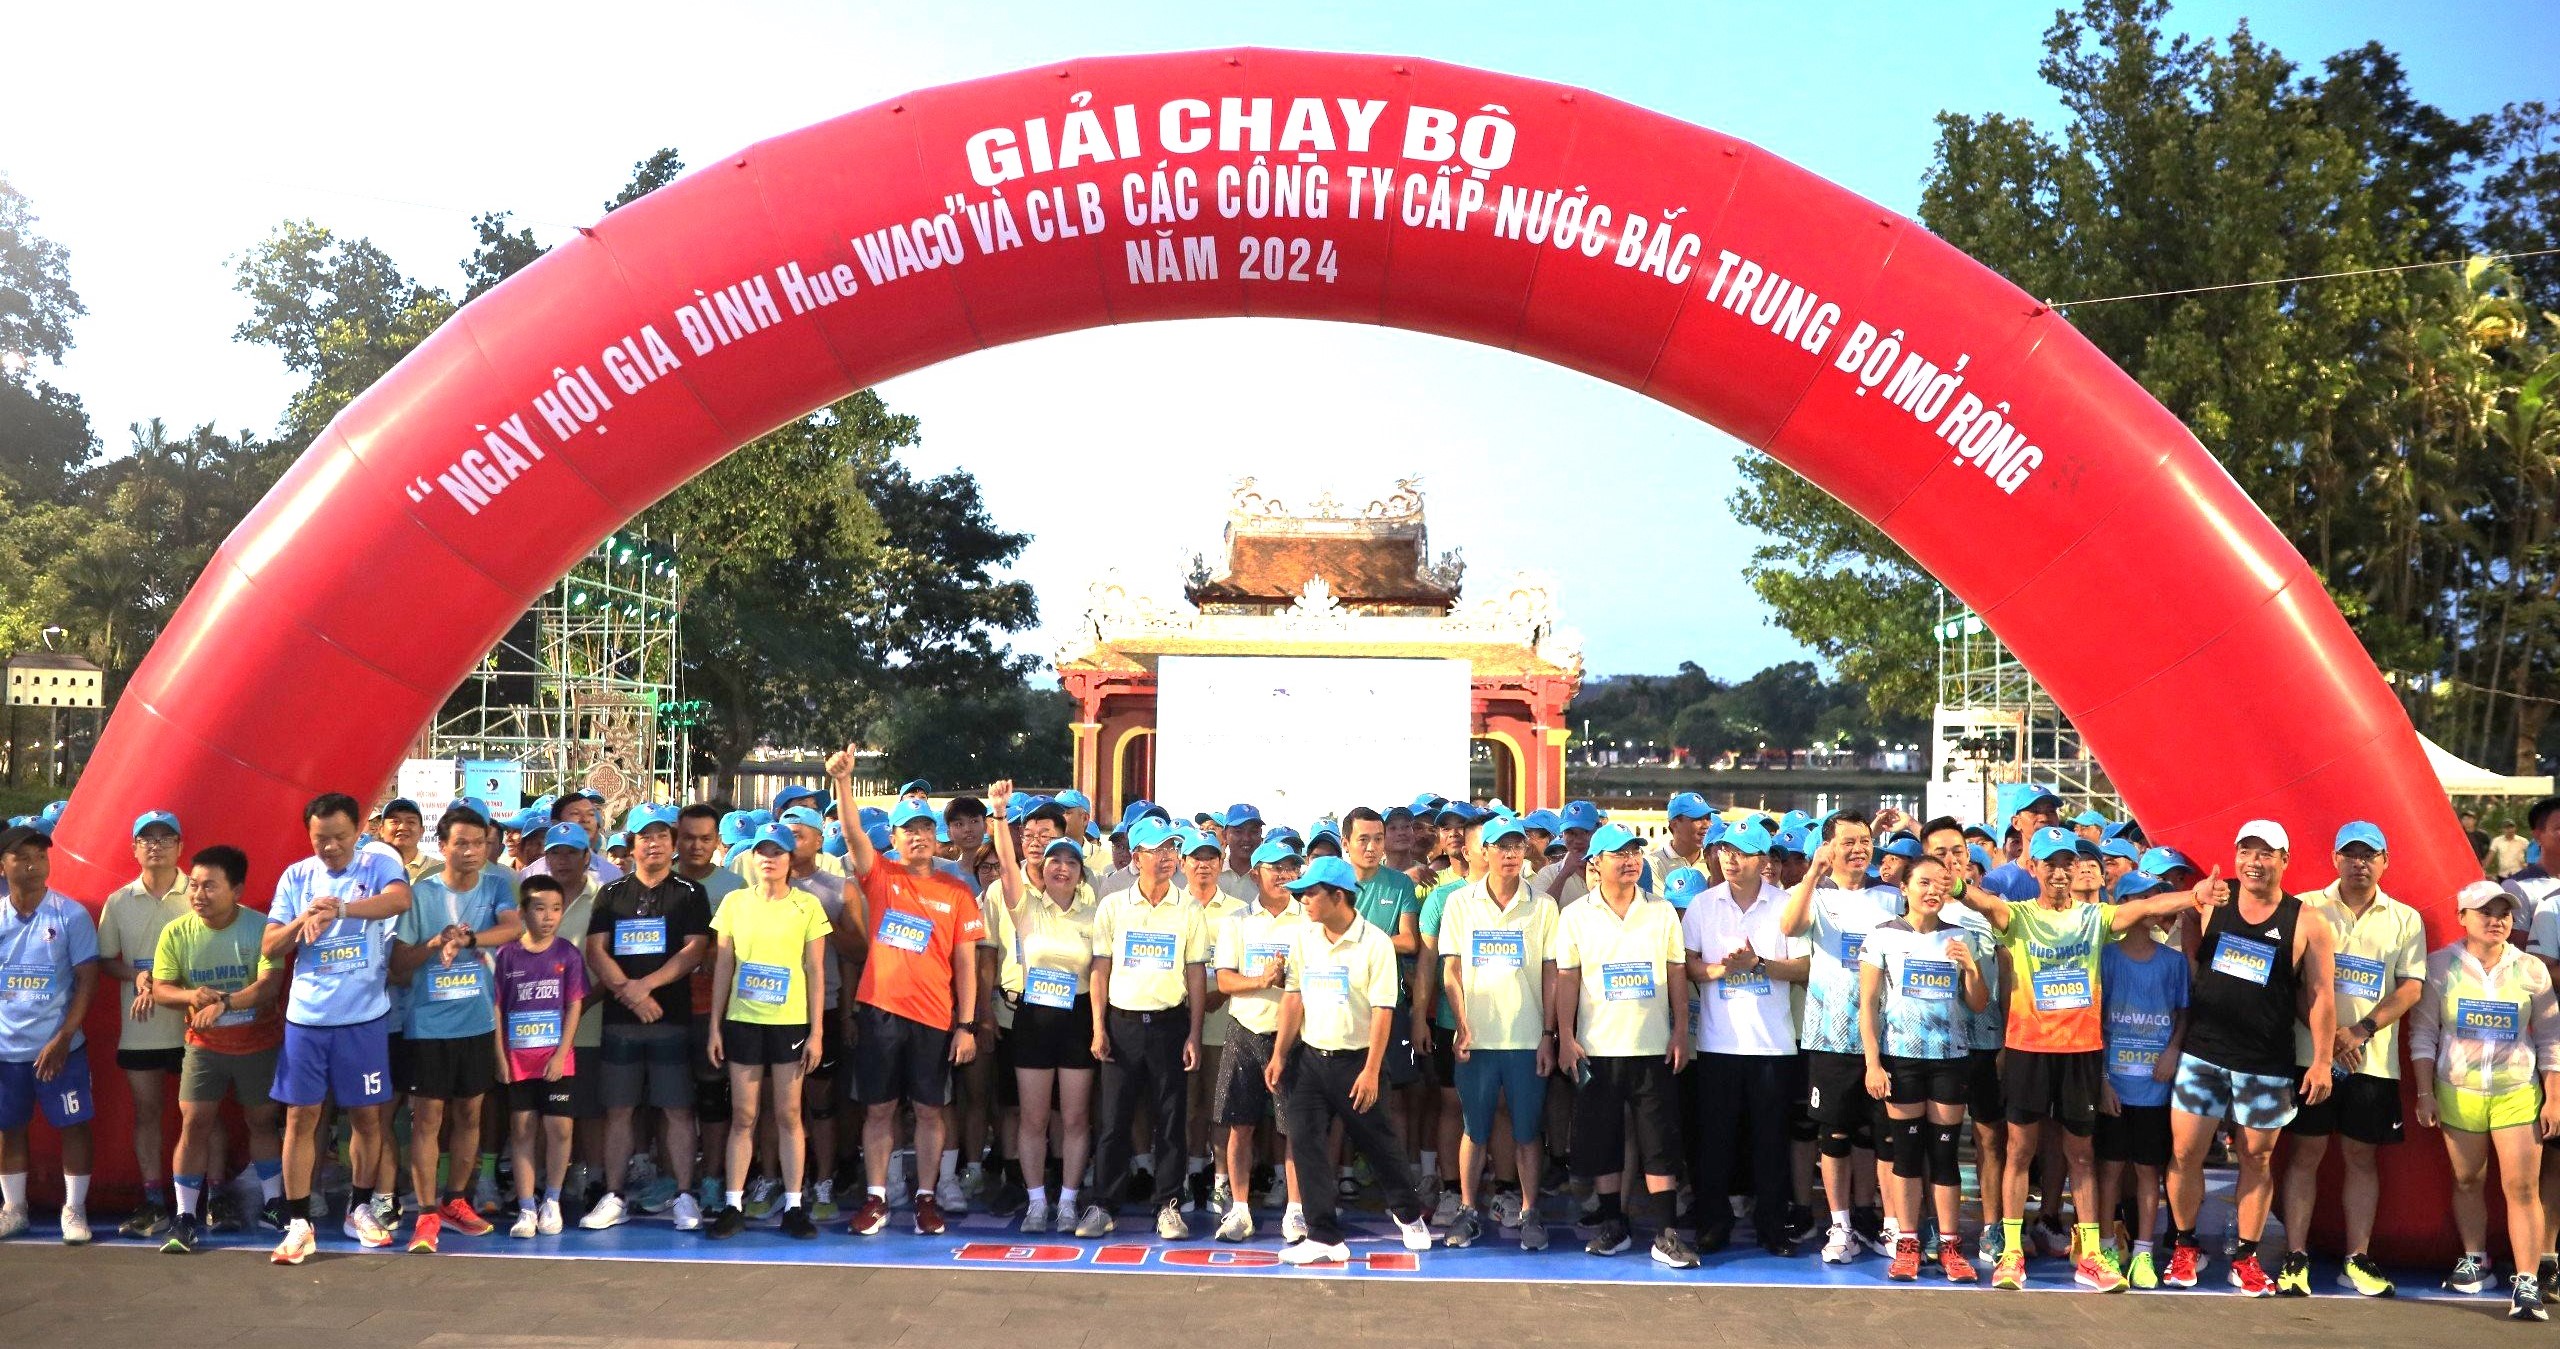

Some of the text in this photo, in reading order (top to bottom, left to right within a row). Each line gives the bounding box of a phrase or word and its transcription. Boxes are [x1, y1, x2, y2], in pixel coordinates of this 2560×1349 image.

[965, 90, 1517, 187] GIẢI CHẠY BỘ
[1125, 228, 1339, 285] NĂM 2024
[532, 366, 614, 442] HỘI
[601, 324, 682, 395] GIA
[674, 275, 783, 357] ĐÌNH
[775, 260, 859, 315] Hue
[965, 187, 1025, 255] VÀ
[1026, 180, 1107, 243] CLB
[1122, 159, 1199, 227] CÁC
[1217, 155, 1330, 220] CÔNG
[1345, 165, 1395, 222] TY
[1401, 163, 1485, 233] CẤP
[1493, 183, 1613, 259] NƯỚC
[1615, 205, 1703, 286] BẮC
[1705, 249, 1842, 358] TRUNG
[1833, 319, 1906, 396] BỘ
[1881, 352, 1972, 424] MỞ
[1935, 399, 2045, 496] RỘNG
[320, 946, 361, 963] 51051
[1131, 944, 1169, 957] 50001
[1479, 943, 1518, 955] 50008
[7, 976, 50, 990] 51057
[435, 973, 476, 988] 50444
[746, 976, 783, 991] 50431
[1611, 975, 1649, 987] 50004
[1910, 973, 1951, 988] 51048
[2334, 967, 2378, 986] 50087
[535, 985, 559, 1000] 2024
[1033, 981, 1071, 997] 50002
[2042, 982, 2085, 997] 50089
[2358, 988, 2378, 998] 5KM
[2111, 1012, 2171, 1026] HueWACO
[2465, 1012, 2512, 1028] 50323
[516, 1022, 554, 1036] 50071
[2491, 1032, 2515, 1040] 5KM
[363, 1071, 381, 1096] 15
[60, 1091, 80, 1115] 16
[1811, 1086, 1820, 1108] 8
